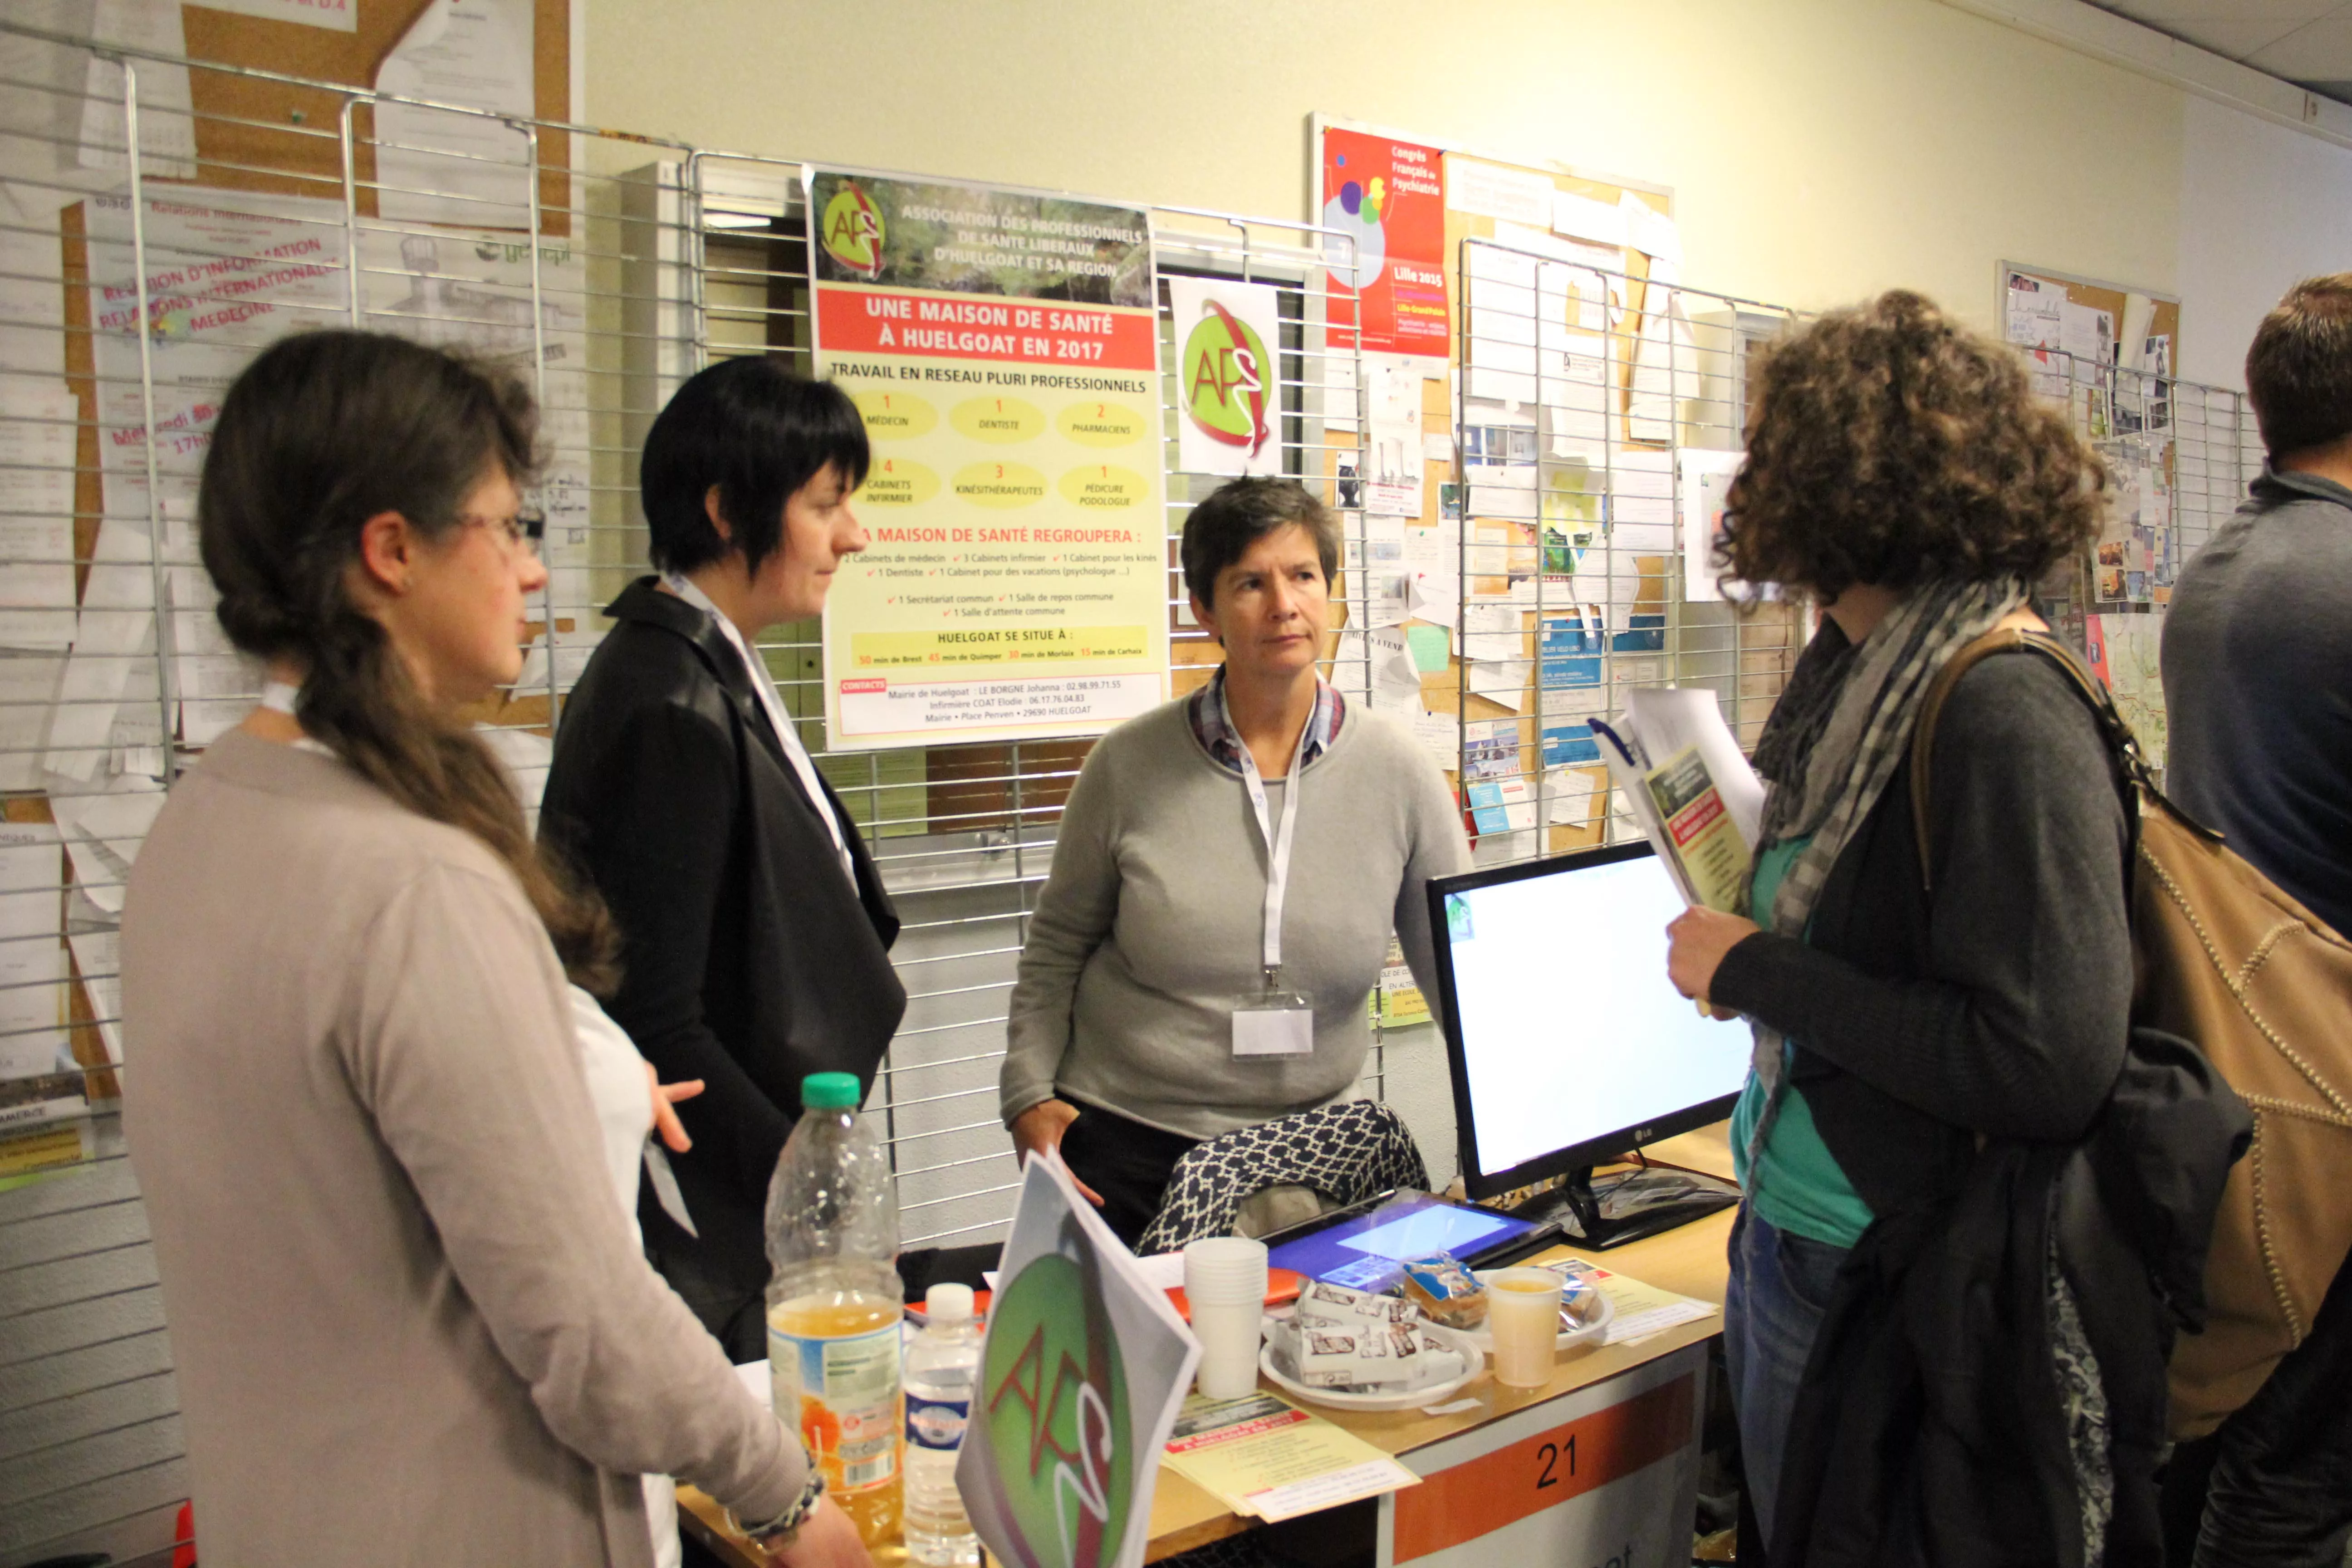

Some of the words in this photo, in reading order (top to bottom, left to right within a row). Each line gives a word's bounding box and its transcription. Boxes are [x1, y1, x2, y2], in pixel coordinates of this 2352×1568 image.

[1392, 146, 1426, 162] Congrès
[1392, 162, 1427, 178] Français
[1392, 177, 1440, 196] Psychiatrie
[902, 205, 997, 228] ASSOCIATION
[1001, 216, 1028, 231] DES
[1031, 219, 1143, 244] PROFESSIONNELS
[958, 230, 978, 245] DE
[934, 248, 1024, 268] D'HUELGOAT
[1027, 257, 1043, 270] ET
[1046, 258, 1065, 272] SA
[1394, 267, 1417, 282] Lille
[1419, 272, 1443, 287] 2015
[866, 297, 912, 319] UNE
[919, 301, 1008, 326] MAISON
[1015, 309, 1042, 329] DE
[1049, 311, 1113, 334] SANTÉ
[879, 322, 896, 346] À
[903, 328, 1016, 354] HUELGOAT
[1023, 338, 1050, 356] EN
[1057, 340, 1104, 360] 2017
[831, 363, 895, 379] TRAVAIL
[900, 367, 920, 380] EN
[926, 368, 982, 384] RESEAU
[987, 372, 1026, 385] PLURI
[1031, 375, 1147, 393] PROFESSIONNELS
[884, 394, 890, 409] 1
[996, 399, 1002, 414] 1
[1097, 404, 1105, 418] 2
[867, 415, 909, 426] MÉDECIN
[979, 419, 1019, 431] DENTISTE
[1072, 423, 1131, 435] PHARMACIENS
[884, 459, 893, 473] 4
[995, 465, 1004, 479] 3
[1101, 466, 1107, 479] 1
[867, 480, 911, 490] CABINETS
[1085, 483, 1124, 494] PÉDICURE
[866, 493, 913, 503] INFIRMIER
[1079, 496, 1131, 506] PODOLOGUE
[877, 528, 946, 543] MAISON
[951, 528, 973, 542] DE
[978, 525, 1029, 543] SANTÉ
[1034, 529, 1132, 543] REGROUPERA
[853, 553, 892, 563] Cabinets
[895, 554, 906, 563] de
[908, 554, 946, 563] médecin
[964, 554, 968, 563] 3
[971, 553, 1008, 563] Cabinets
[1010, 554, 1046, 562] infirmier
[1069, 553, 1100, 562] Cabinet
[1102, 555, 1121, 565] pour
[1123, 553, 1134, 562] les
[1137, 553, 1157, 562] kinés
[886, 568, 924, 577] Dentiste
[947, 568, 980, 577] Cabinet
[983, 569, 1002, 579] pour
[1005, 568, 1019, 576] des
[1022, 567, 1061, 575] vacations
[1063, 567, 1116, 578] (psychologue
[899, 596, 903, 604] 1
[906, 595, 953, 604] Secrétariat
[956, 595, 994, 603] commun
[1016, 593, 1036, 602] Salle
[1038, 593, 1048, 602] de
[1050, 594, 1073, 603] repos
[1075, 593, 1114, 602] commune
[961, 608, 982, 617] Salle
[984, 608, 1023, 616] d'attente
[1025, 607, 1065, 615] commune
[938, 632, 1001, 643] HUELGOAT
[1004, 631, 1019, 641] SE
[1022, 630, 1054, 641] SITUE
[1058, 628, 1066, 639] À
[873, 656, 889, 664] min
[902, 655, 922, 663] Brest
[970, 653, 1002, 662] Quimper
[1047, 649, 1074, 657] Morlaix
[1081, 647, 1091, 657] 15
[842, 681, 885, 691] CONTACTS
[888, 691, 915, 700] Mairie
[918, 689, 929, 698] de
[931, 688, 970, 699] Huelgoat
[979, 686, 988, 695] LE
[991, 684, 1024, 695] BORGNE
[1027, 683, 1060, 693] Johanna
[929, 701, 970, 710] Infirmière
[973, 698, 995, 707] COAT
[998, 697, 1022, 706] Elodie
[925, 713, 952, 723] Mairie
[961, 711, 982, 720] Place
[985, 710, 1014, 719] Penven
[1049, 705, 1092, 715] HUELGOAT
[1537, 1434, 1575, 1490] 21
